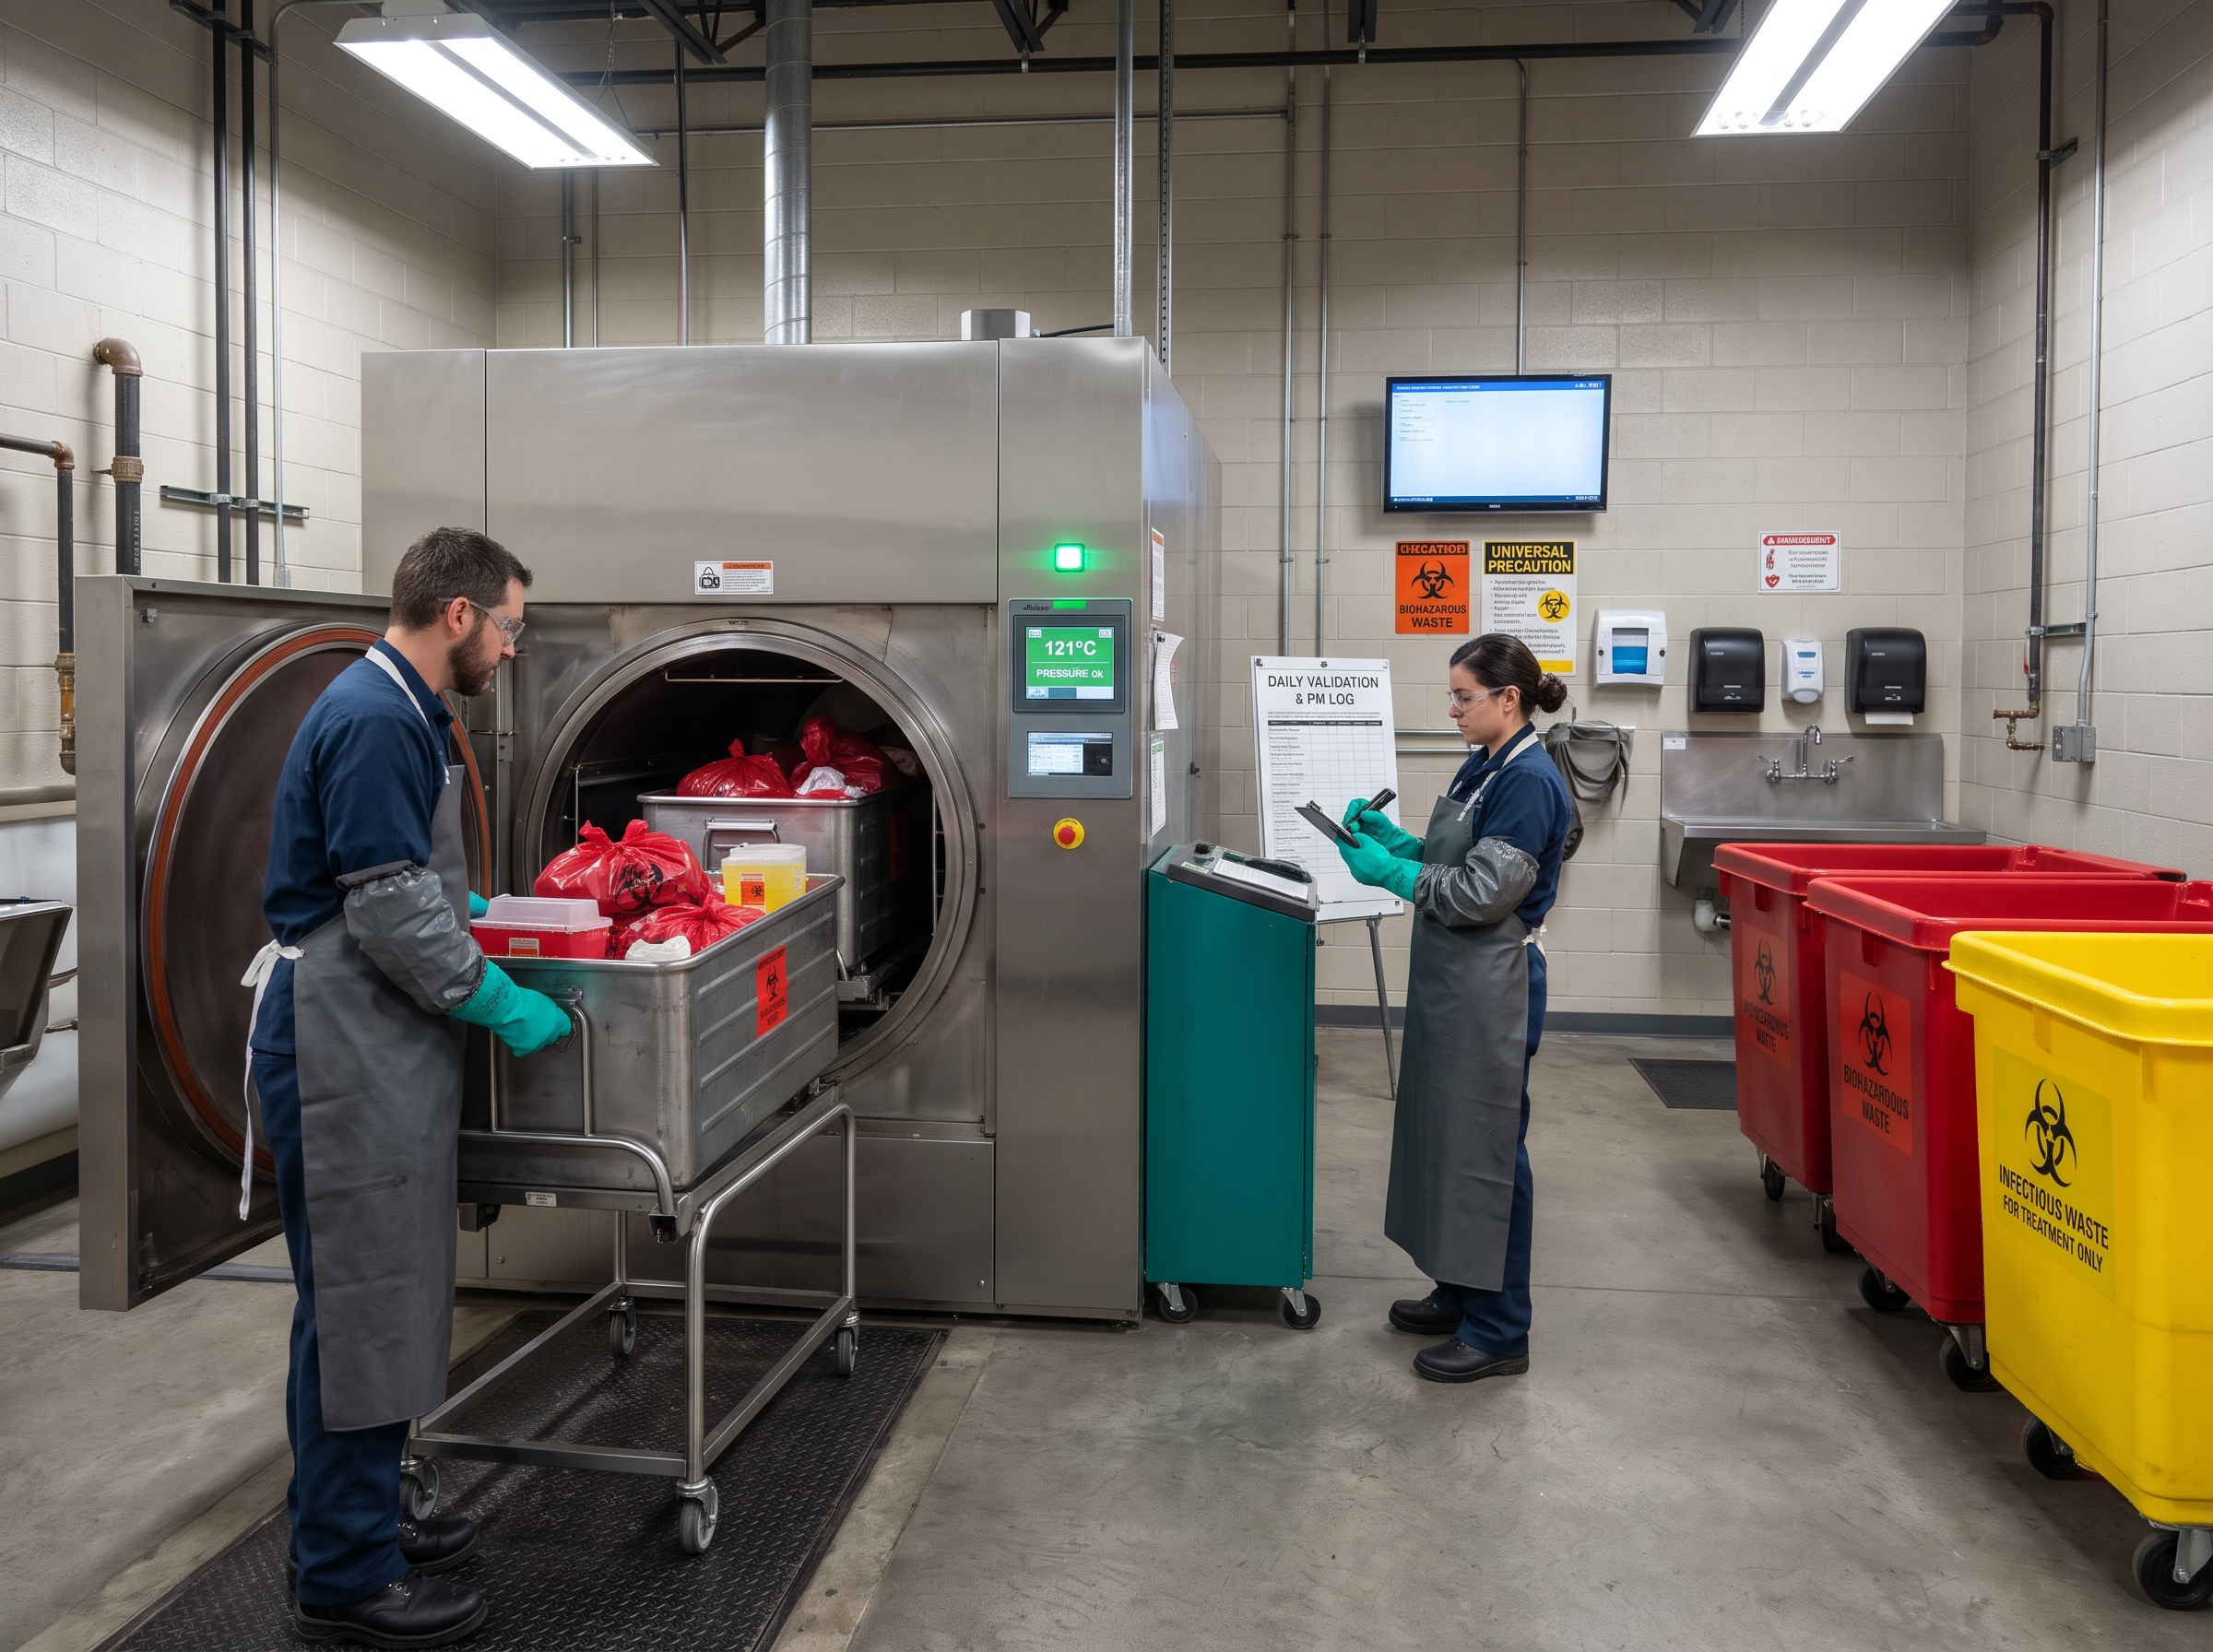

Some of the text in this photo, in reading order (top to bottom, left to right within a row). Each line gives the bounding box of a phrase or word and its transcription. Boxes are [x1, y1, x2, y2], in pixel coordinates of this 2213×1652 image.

[1491, 545, 1568, 558] UNIVERSAL
[1488, 560, 1571, 572] PRECAUTION
[1400, 605, 1466, 614] BIOHAZAROUS
[1412, 617, 1453, 628] WASTE
[1036, 669, 1089, 678] PRESSURE
[1268, 675, 1379, 688] DAILY VALIDATION
[1296, 693, 1355, 705] & PM LOG
[1844, 1064, 1909, 1120] BIOHAZARDOUS
[1862, 1099, 1890, 1135] WASTE
[1999, 1163, 2109, 1251] INFECTIOUS WASTE
[2003, 1194, 2103, 1273] FOR TREATMENT ONLY
